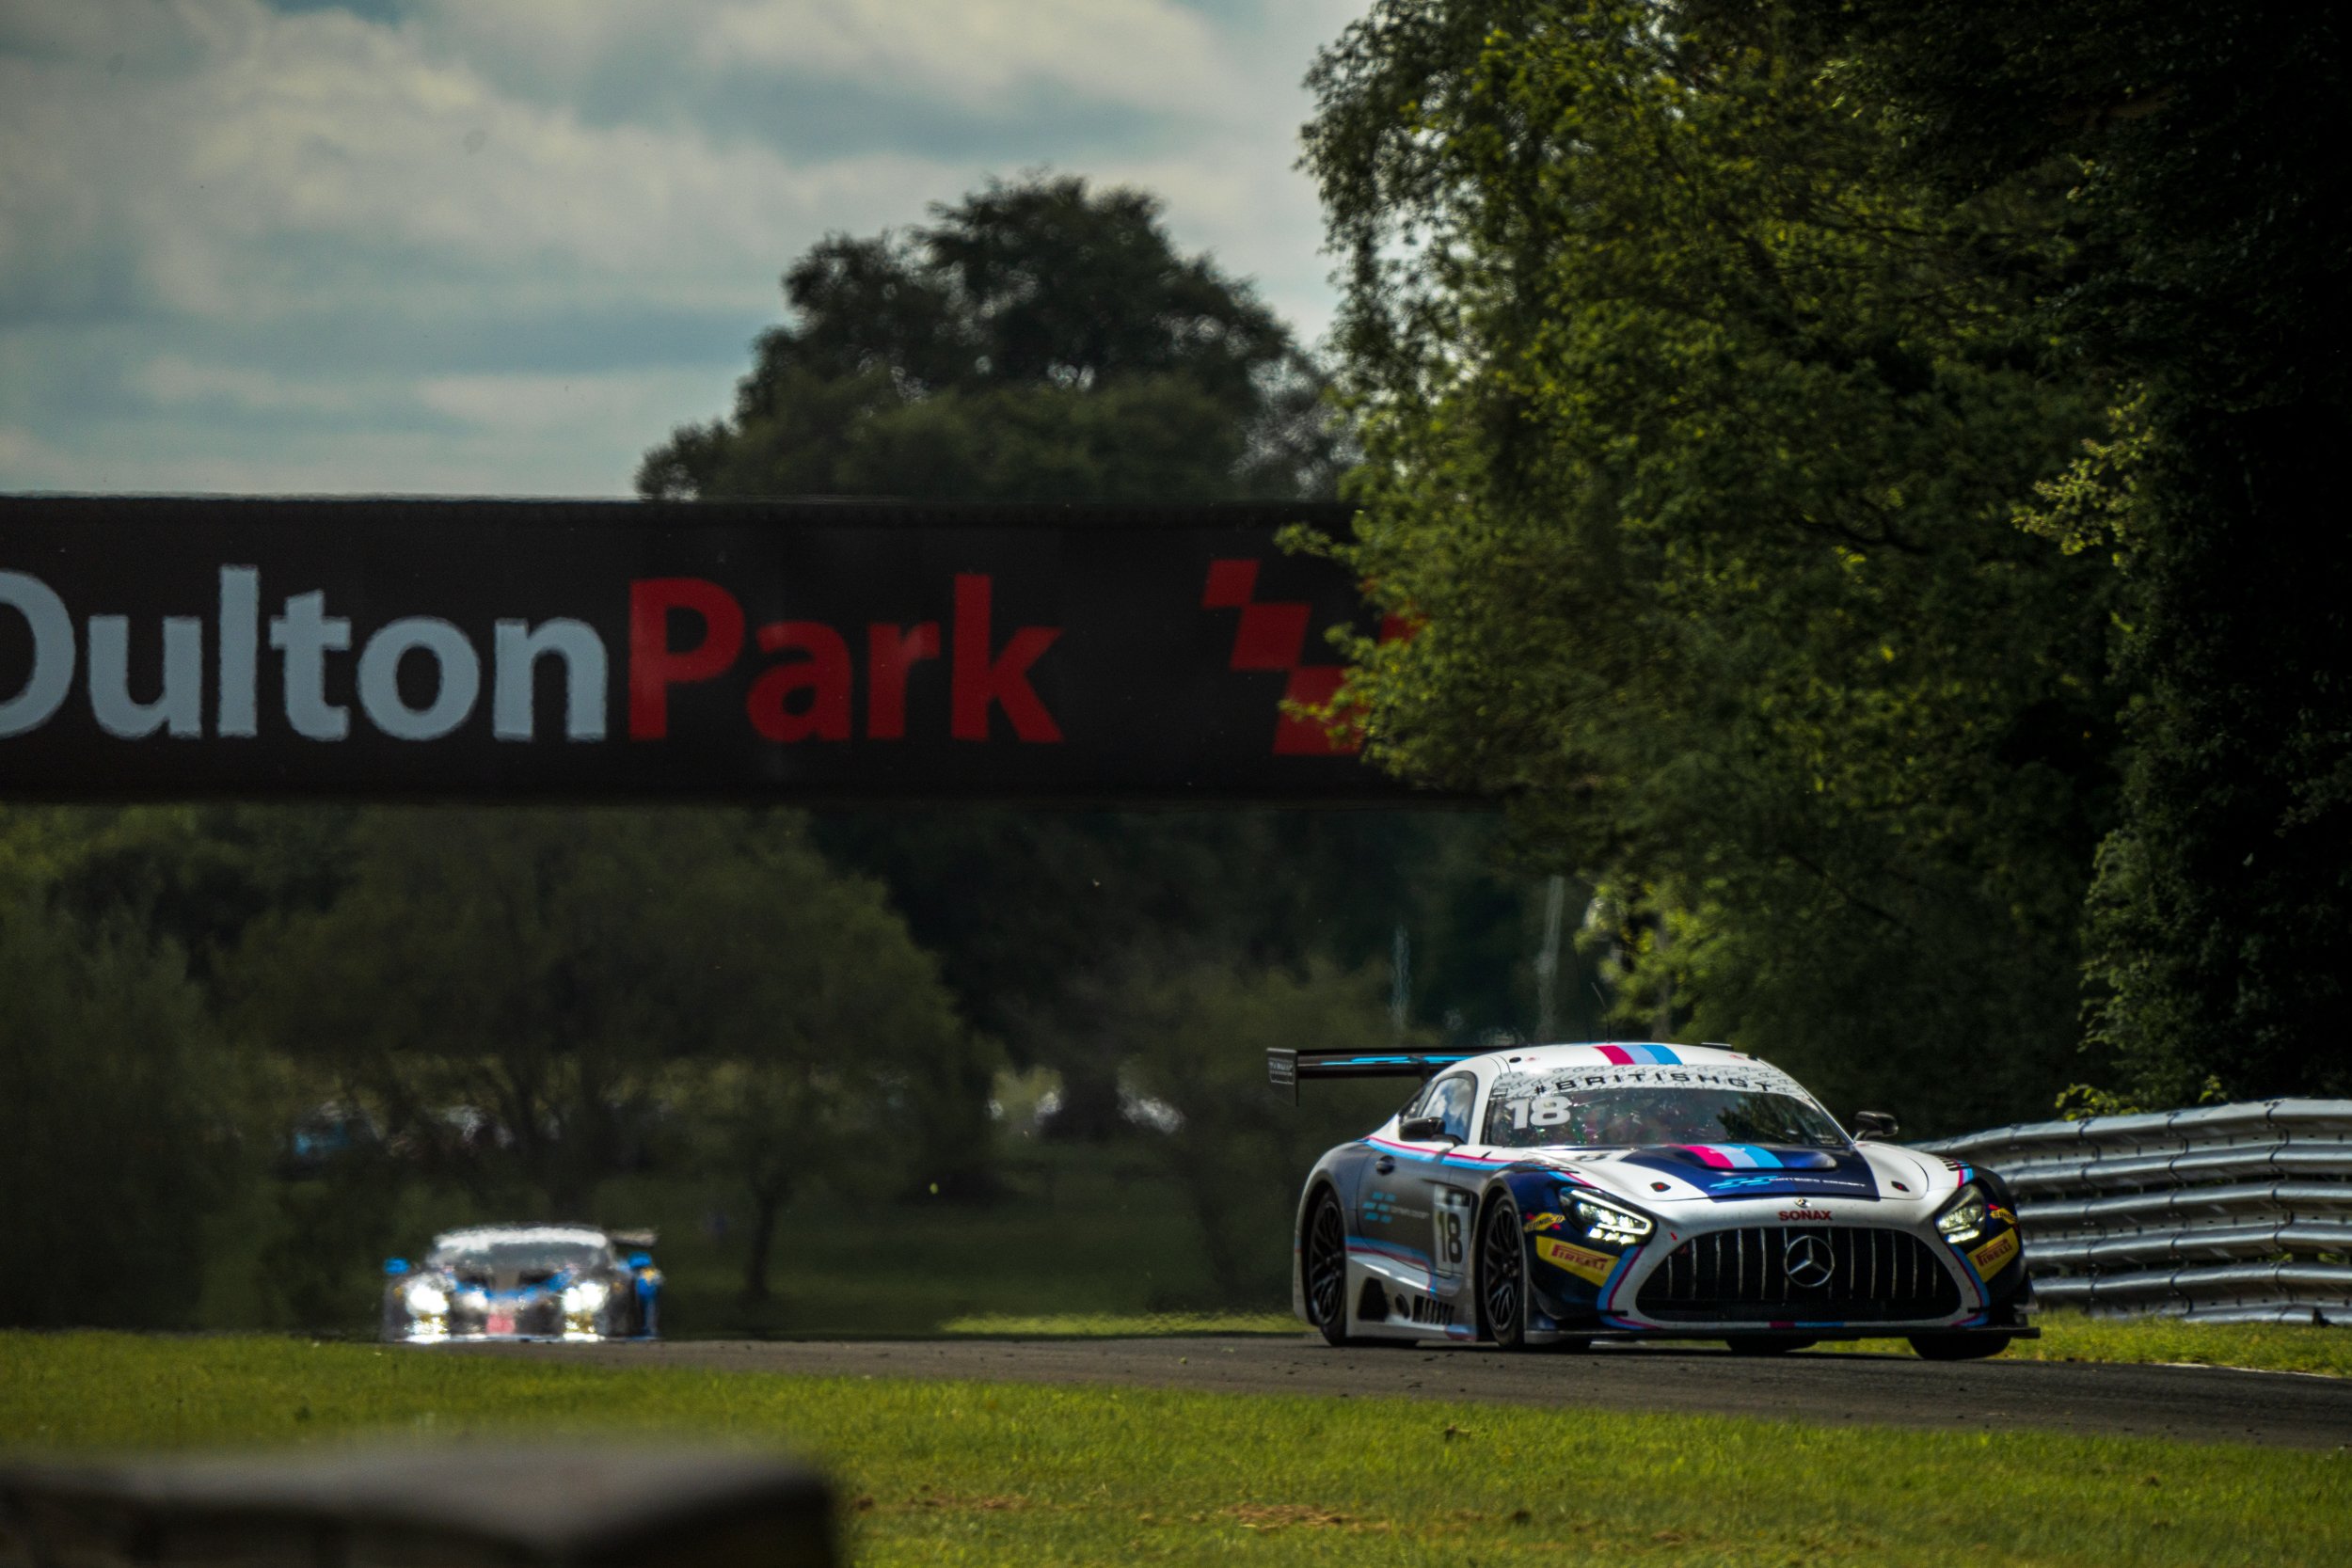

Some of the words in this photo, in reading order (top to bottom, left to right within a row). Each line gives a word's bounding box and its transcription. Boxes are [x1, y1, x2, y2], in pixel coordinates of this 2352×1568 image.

[1505, 1096, 1572, 1129] 18
[1778, 1210, 1833, 1221] SONAX
[1976, 1238, 2012, 1266] PIRELLI
